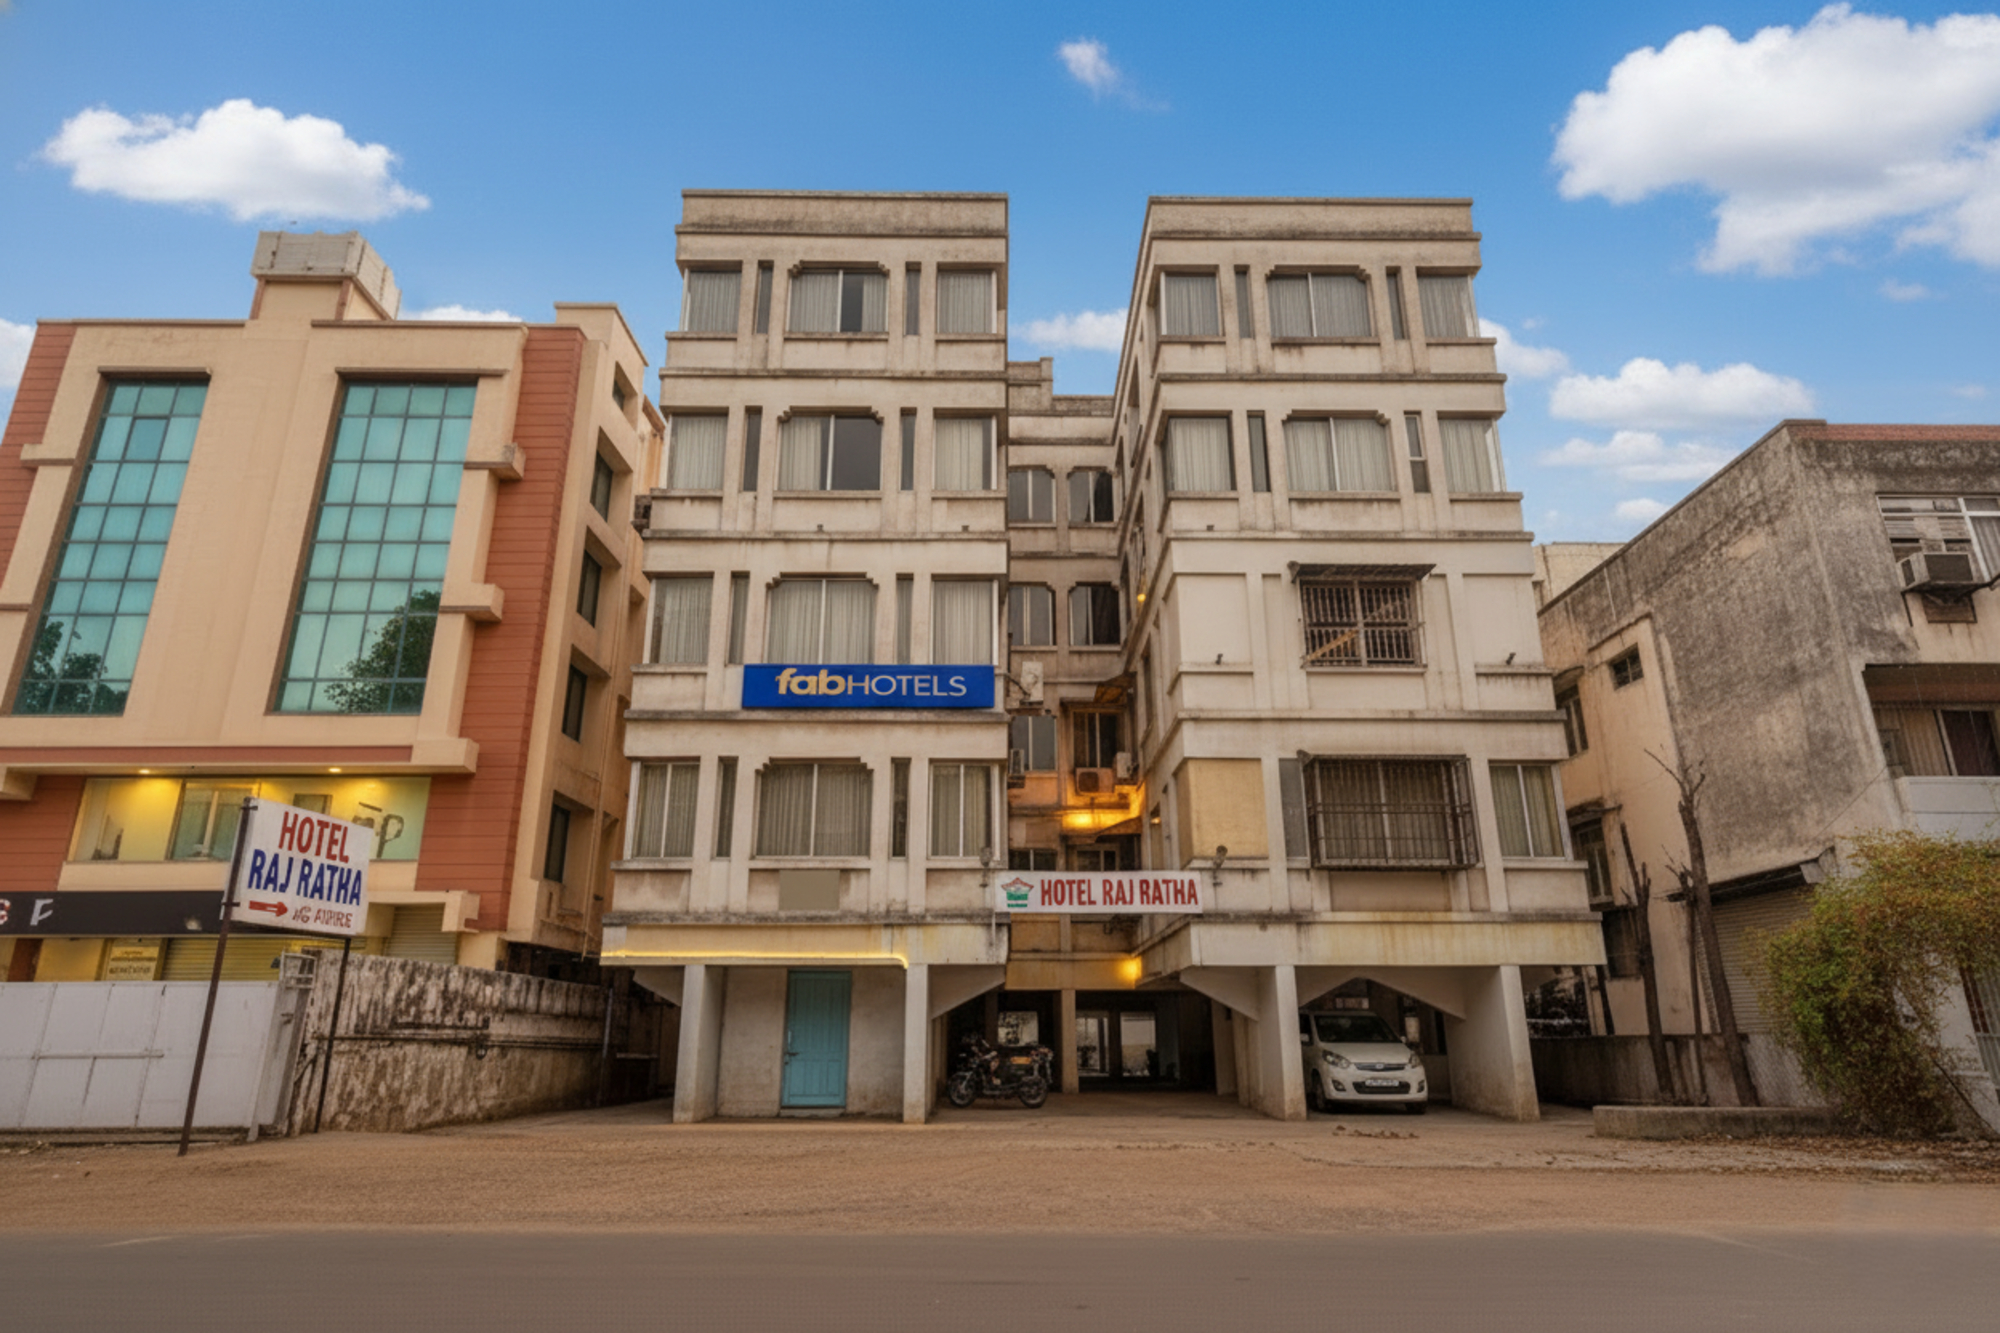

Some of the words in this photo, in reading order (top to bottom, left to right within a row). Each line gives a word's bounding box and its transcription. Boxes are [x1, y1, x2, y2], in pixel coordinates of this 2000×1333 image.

[775, 667, 967, 697] fabHOTELS
[278, 811, 349, 864] HOTEL
[247, 848, 294, 893] RAJ
[296, 858, 362, 906] RATHA
[1040, 878, 1097, 906] HOTEL
[1102, 878, 1134, 906] RAJ
[1139, 878, 1199, 906] RATHA
